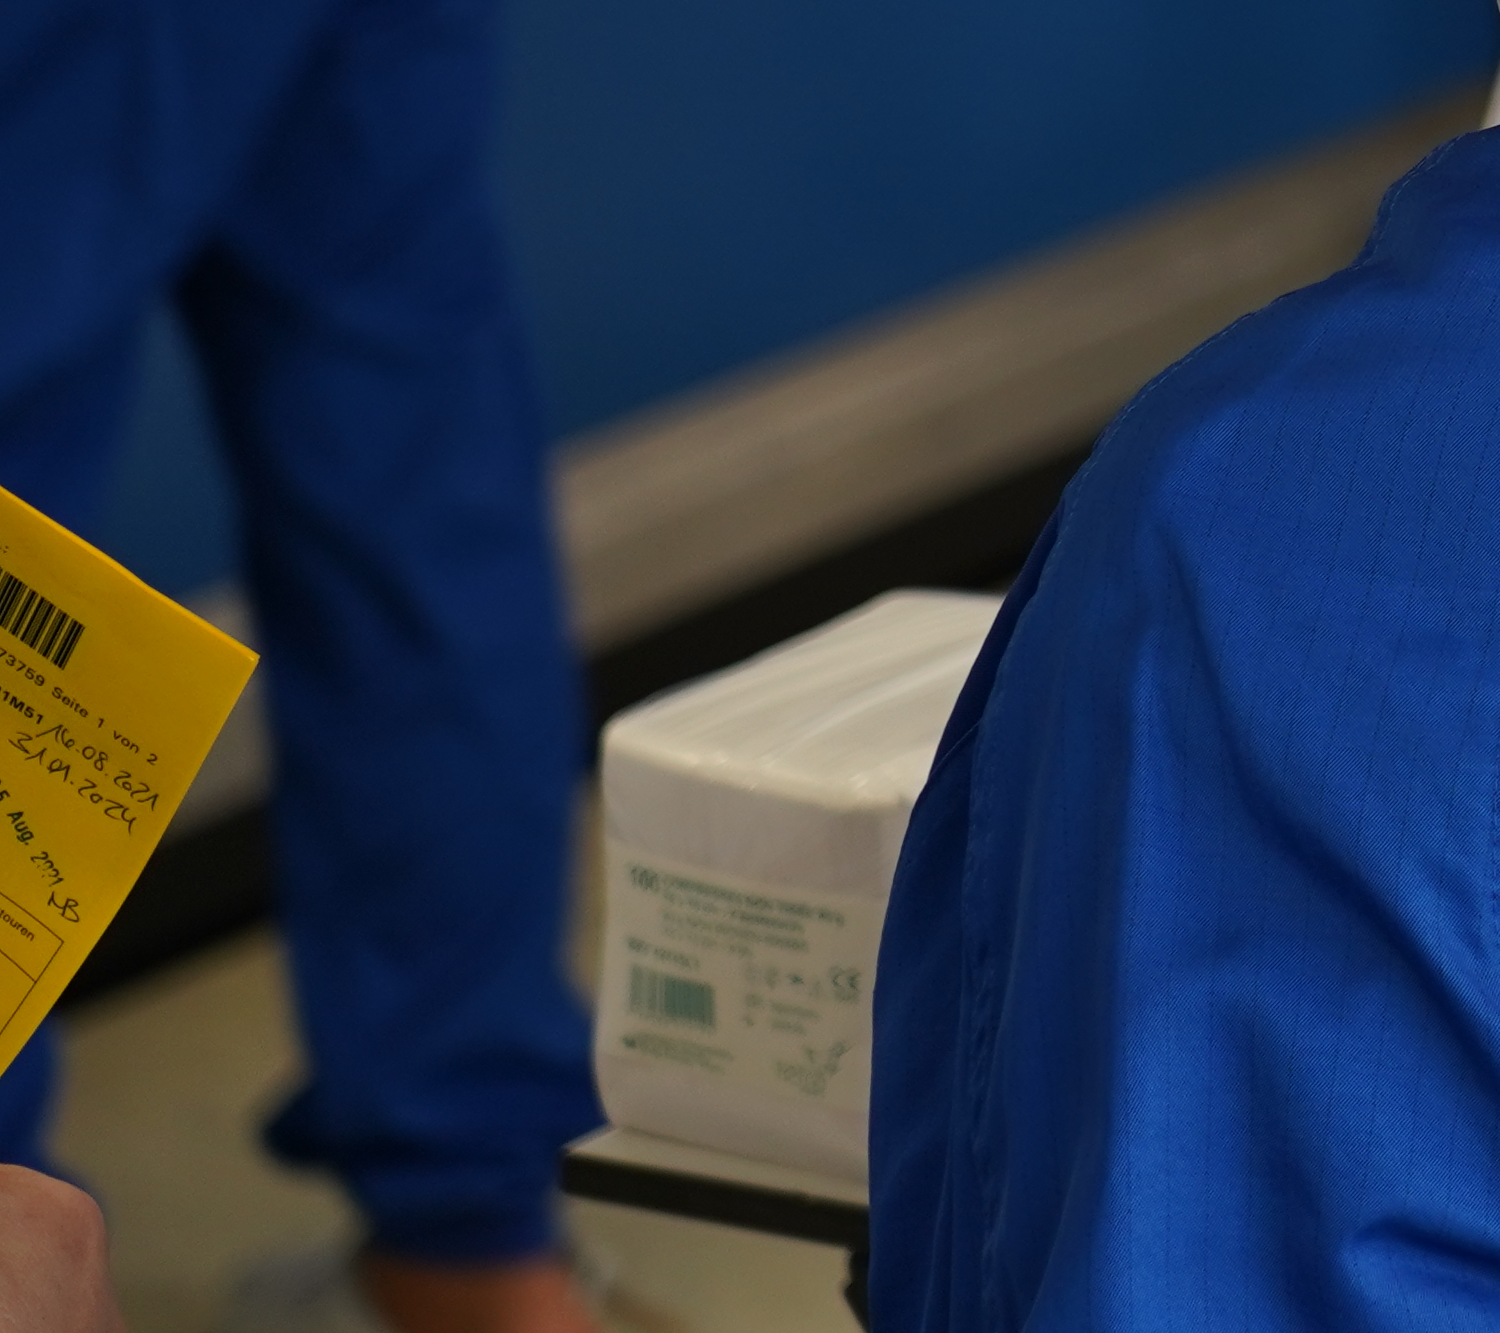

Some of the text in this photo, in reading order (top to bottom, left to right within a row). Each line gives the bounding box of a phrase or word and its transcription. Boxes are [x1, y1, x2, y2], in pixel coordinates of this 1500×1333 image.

[0, 687, 44, 724] 1M51
[52, 686, 89, 719] Seite
[98, 718, 105, 729] 1
[113, 730, 140, 755] von
[147, 753, 159, 765] 2
[7, 810, 35, 846] Aug.
[0, 908, 35, 942] touren
